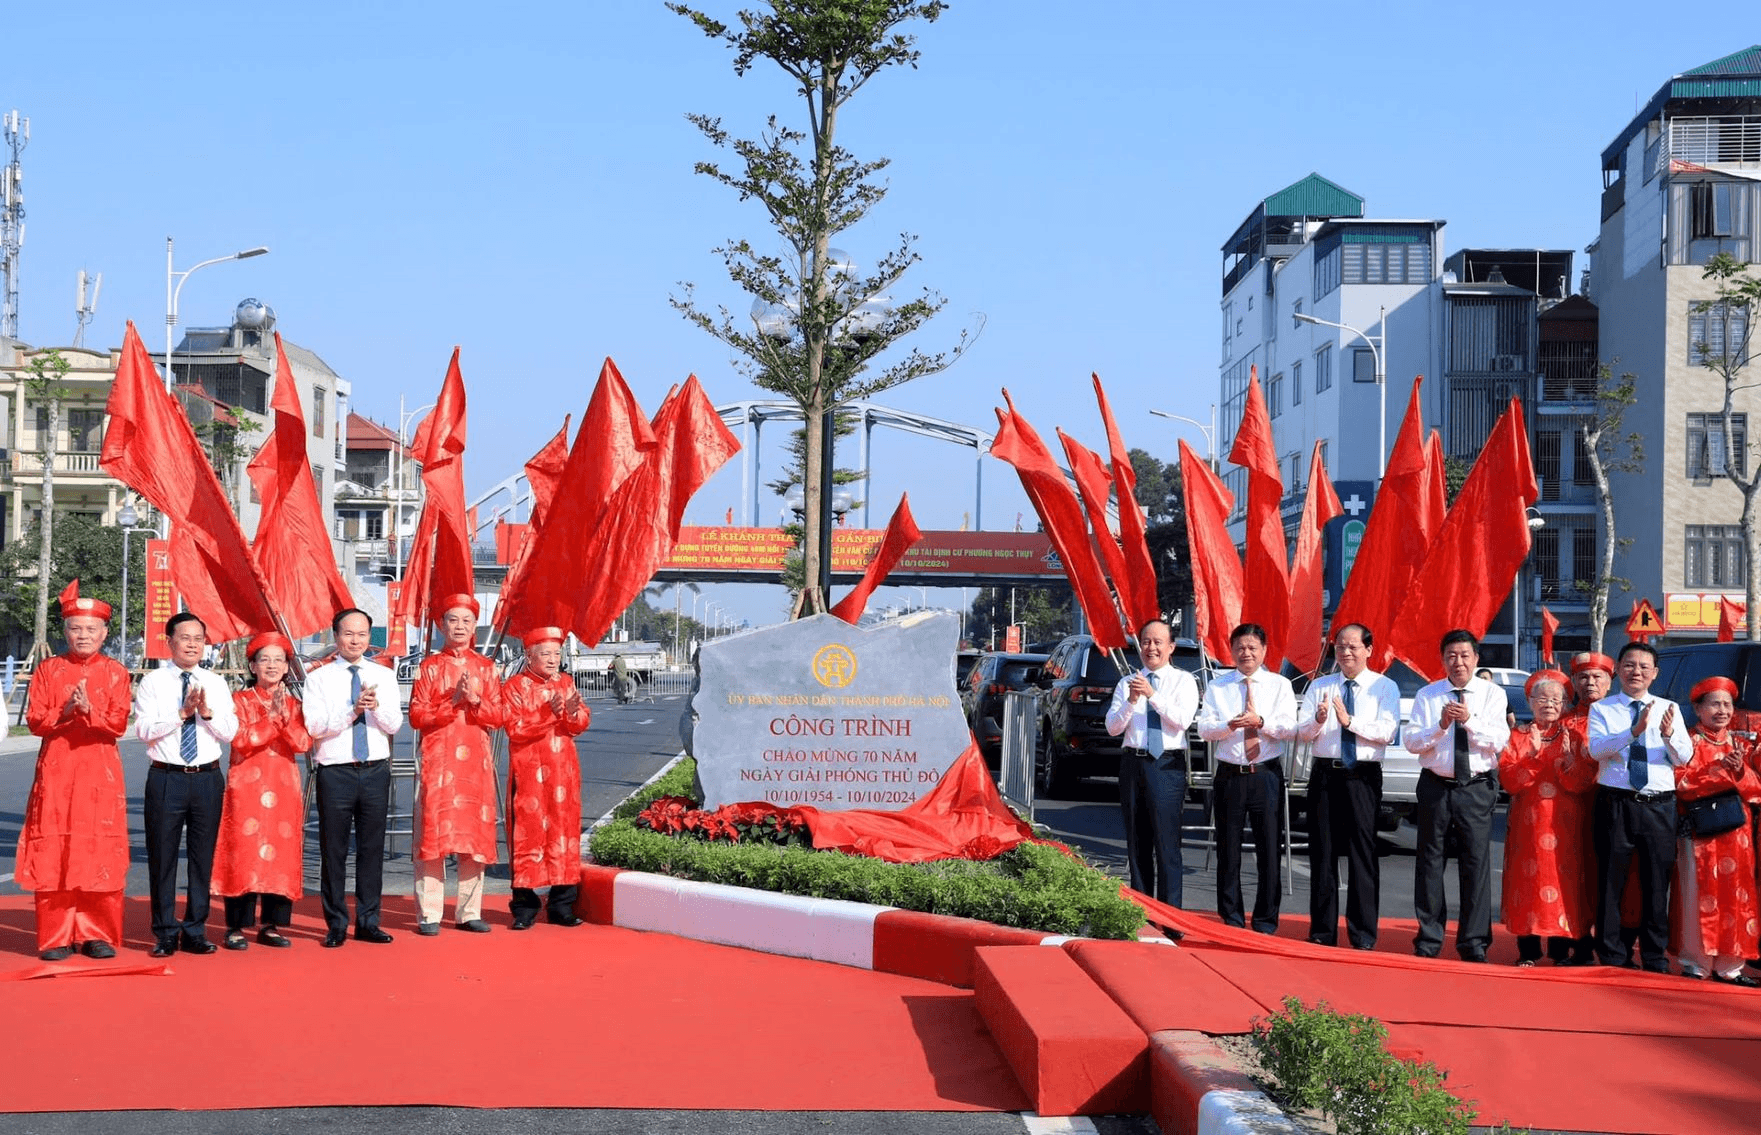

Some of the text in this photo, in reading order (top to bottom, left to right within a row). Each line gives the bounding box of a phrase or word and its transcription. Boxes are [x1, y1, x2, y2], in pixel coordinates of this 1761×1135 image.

[720, 532, 765, 542] KHÁNH
[769, 713, 912, 737] CÔNG TRÌNH
[763, 747, 917, 763] CHÀO MỪNG 70 NĂM
[740, 766, 940, 783] NGÀY GIẢI PHÓNG THỦ ĐÔ
[764, 790, 833, 803] 10/10/1954
[848, 790, 917, 804] 10/10/2024
